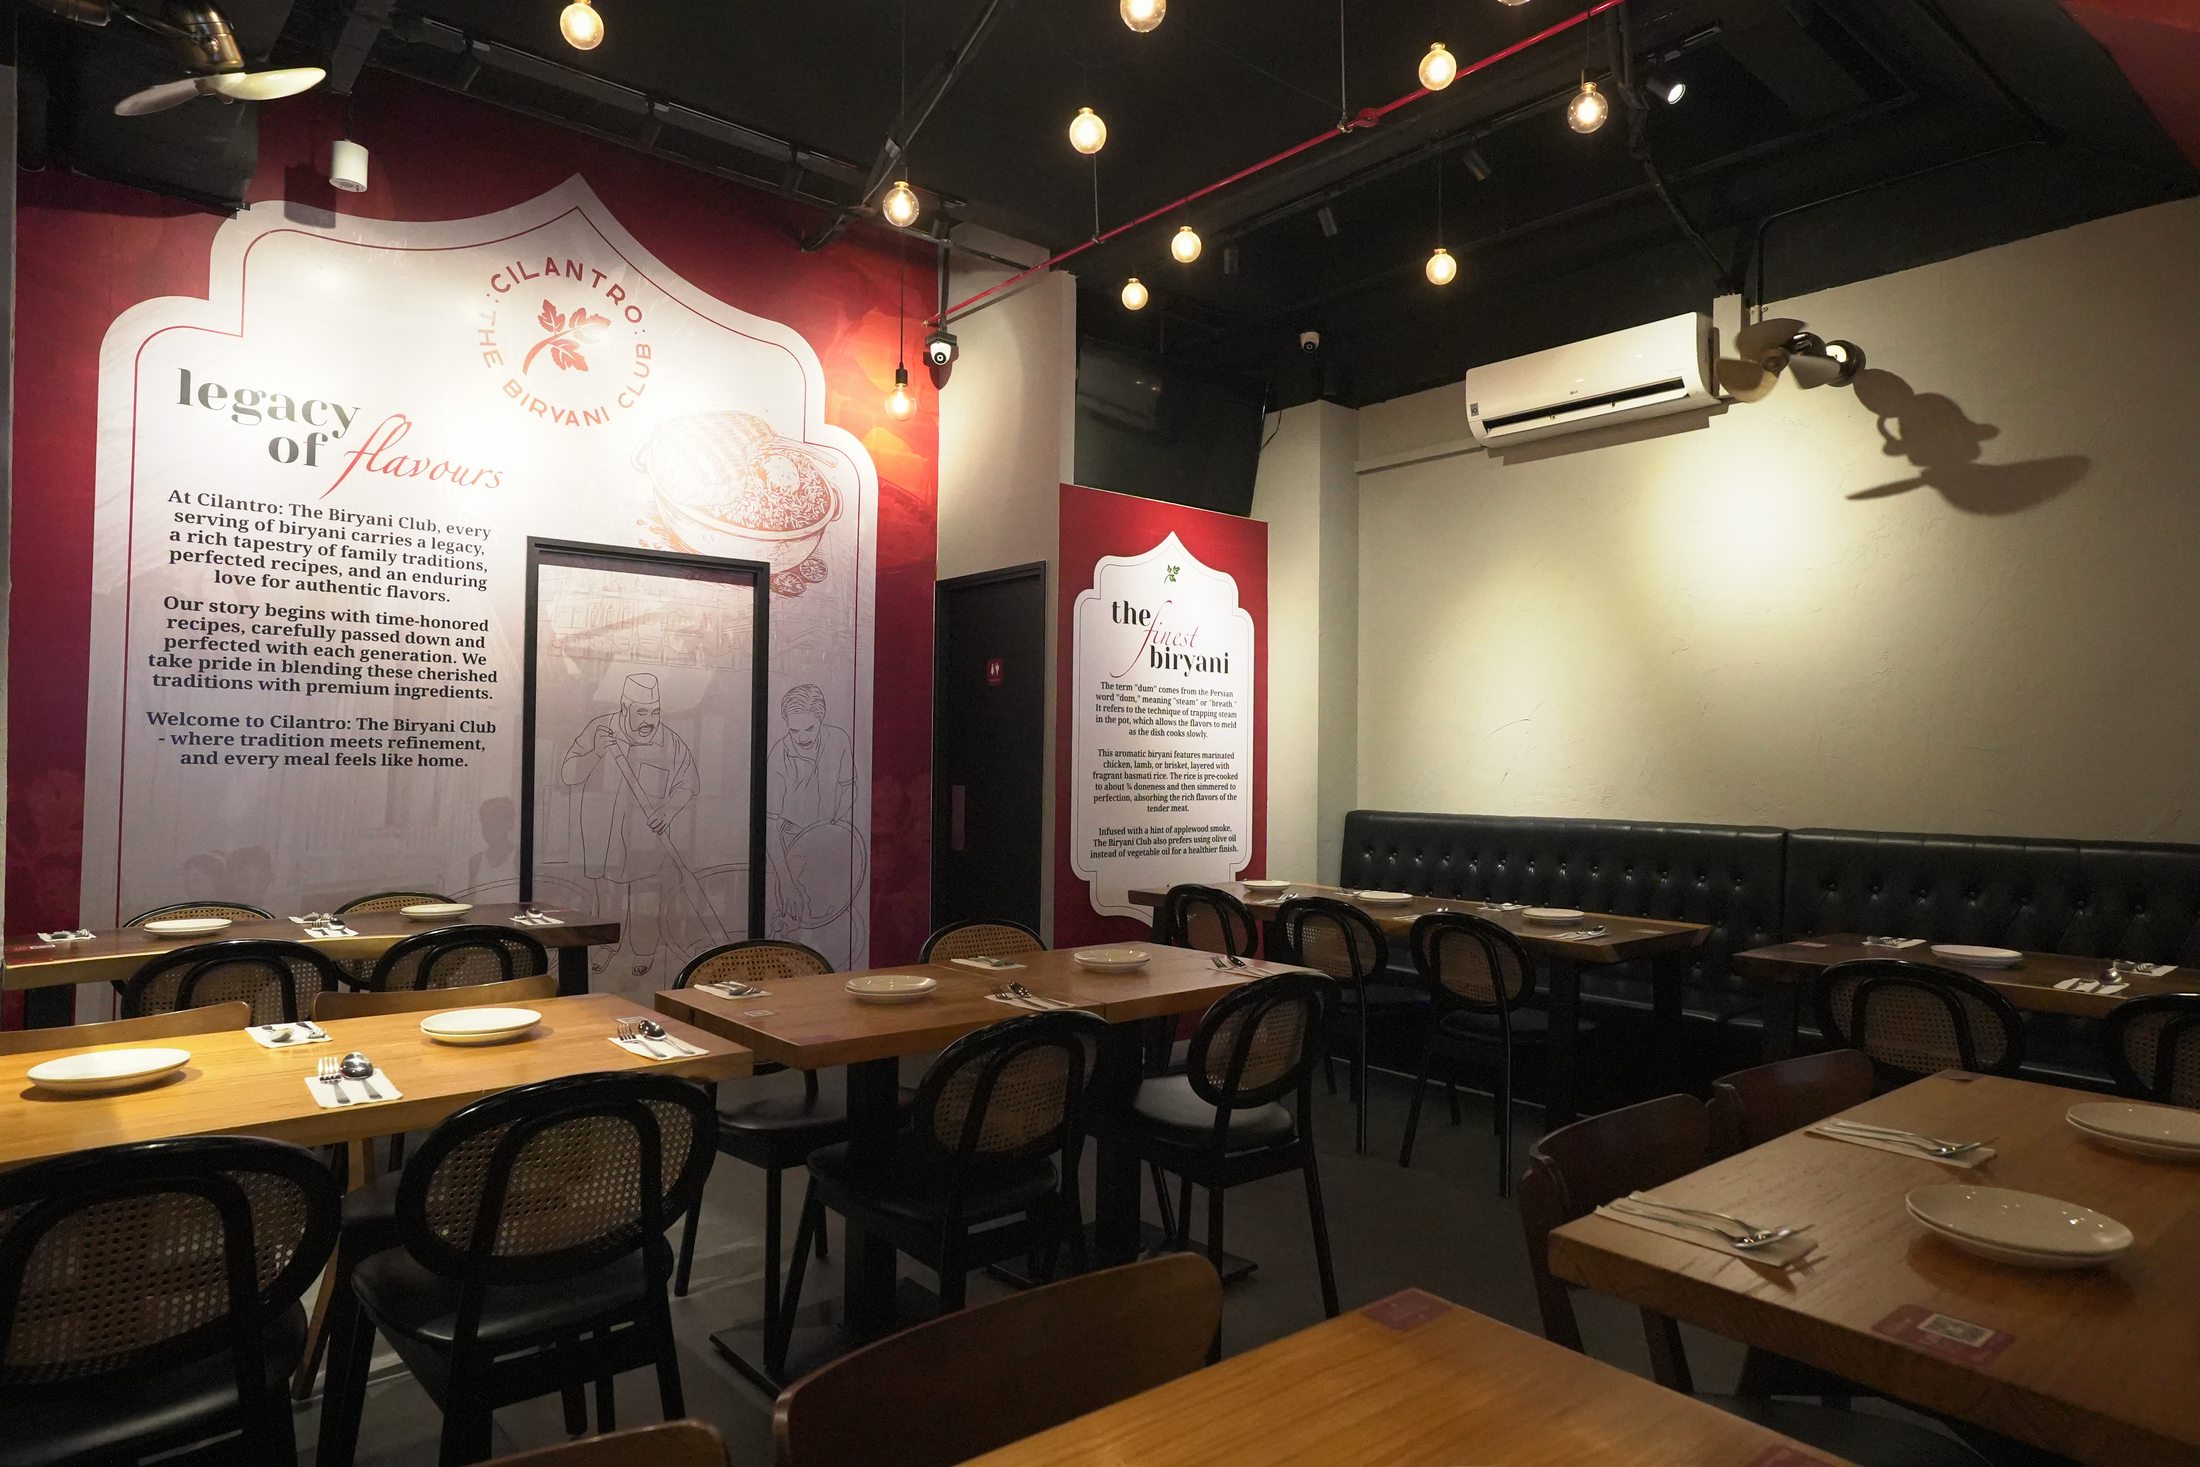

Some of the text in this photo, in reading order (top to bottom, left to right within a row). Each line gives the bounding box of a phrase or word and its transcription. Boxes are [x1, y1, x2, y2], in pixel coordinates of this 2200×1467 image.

[490, 256, 642, 324] CILANTRO
[478, 311, 652, 427] THE BIRYANI CLUB
[176, 367, 361, 439] legacy
[267, 413, 503, 500] of flavours
[168, 490, 491, 541] At Cilantro: The Biryani Club, every
[174, 511, 485, 557] serving of biryani carries a legacy,
[170, 530, 488, 573] a rich tapestry of family traditions,
[169, 550, 487, 591] perfected recipes, and an enduring
[214, 570, 450, 602] love for authentic flavors.
[164, 596, 489, 632] Our story begins with time-honored
[1112, 600, 1151, 627] the
[166, 617, 485, 649] recipes, carefully passed down and
[1109, 600, 1201, 678] finest
[163, 636, 487, 665] perfected with each generation. We
[1150, 645, 1229, 677] biryani
[148, 654, 498, 683] take pride in blending these cherished
[153, 673, 493, 700] traditions with premium ingredients.
[1100, 682, 1114, 690] The
[1116, 683, 1133, 691] term
[1135, 684, 1157, 692] "dum"
[1181, 687, 1197, 695] from
[1198, 688, 1209, 696] the
[1210, 689, 1233, 697] Persian
[146, 711, 496, 736] Welcome to Cilantro: The Biryani Club
[1096, 704, 1101, 712] It
[1103, 704, 1125, 713] refers
[1135, 706, 1146, 714] the
[1147, 707, 1181, 717] technique
[1182, 708, 1189, 716] of
[1190, 709, 1217, 719] trapping
[1096, 715, 1103, 723] in
[1105, 715, 1116, 723] the
[1118, 717, 1131, 726] pot,
[1133, 717, 1153, 725] which
[1155, 717, 1177, 726] allows
[1190, 719, 1212, 727] flavors
[170, 731, 235, 746] where
[240, 733, 325, 747] tradition
[330, 737, 383, 749] meets
[388, 736, 486, 752] refinement,
[1138, 728, 1149, 736] the
[1151, 728, 1165, 736] dish
[1167, 729, 1185, 737] cooks
[180, 751, 468, 769] and every meal feels like home.
[1098, 749, 1113, 757] This
[1148, 750, 1172, 760] biryani
[1174, 750, 1200, 759] features
[1103, 760, 1132, 769] chicken,
[1134, 761, 1153, 769] lamb,
[1164, 761, 1189, 770] brisket,
[1191, 762, 1214, 771] layered
[1093, 771, 1122, 781] fragrant
[1204, 773, 1238, 782] pre-cooked
[1093, 794, 1132, 804] perfection,
[1134, 793, 1168, 803] absorbing
[1182, 793, 1195, 801] rich
[1147, 804, 1170, 812] tender
[1093, 839, 1107, 847] The
[1109, 838, 1134, 848] Biryani
[1136, 837, 1152, 845] Club
[1153, 837, 1167, 845] also
[1168, 836, 1192, 846] prefers
[1194, 835, 1210, 845] using
[1228, 834, 1236, 842] oil
[1099, 827, 1126, 836] Infused
[1127, 826, 1143, 835] with
[1150, 826, 1164, 834] hint
[1166, 825, 1173, 833] of
[1174, 825, 1209, 835] applewood
